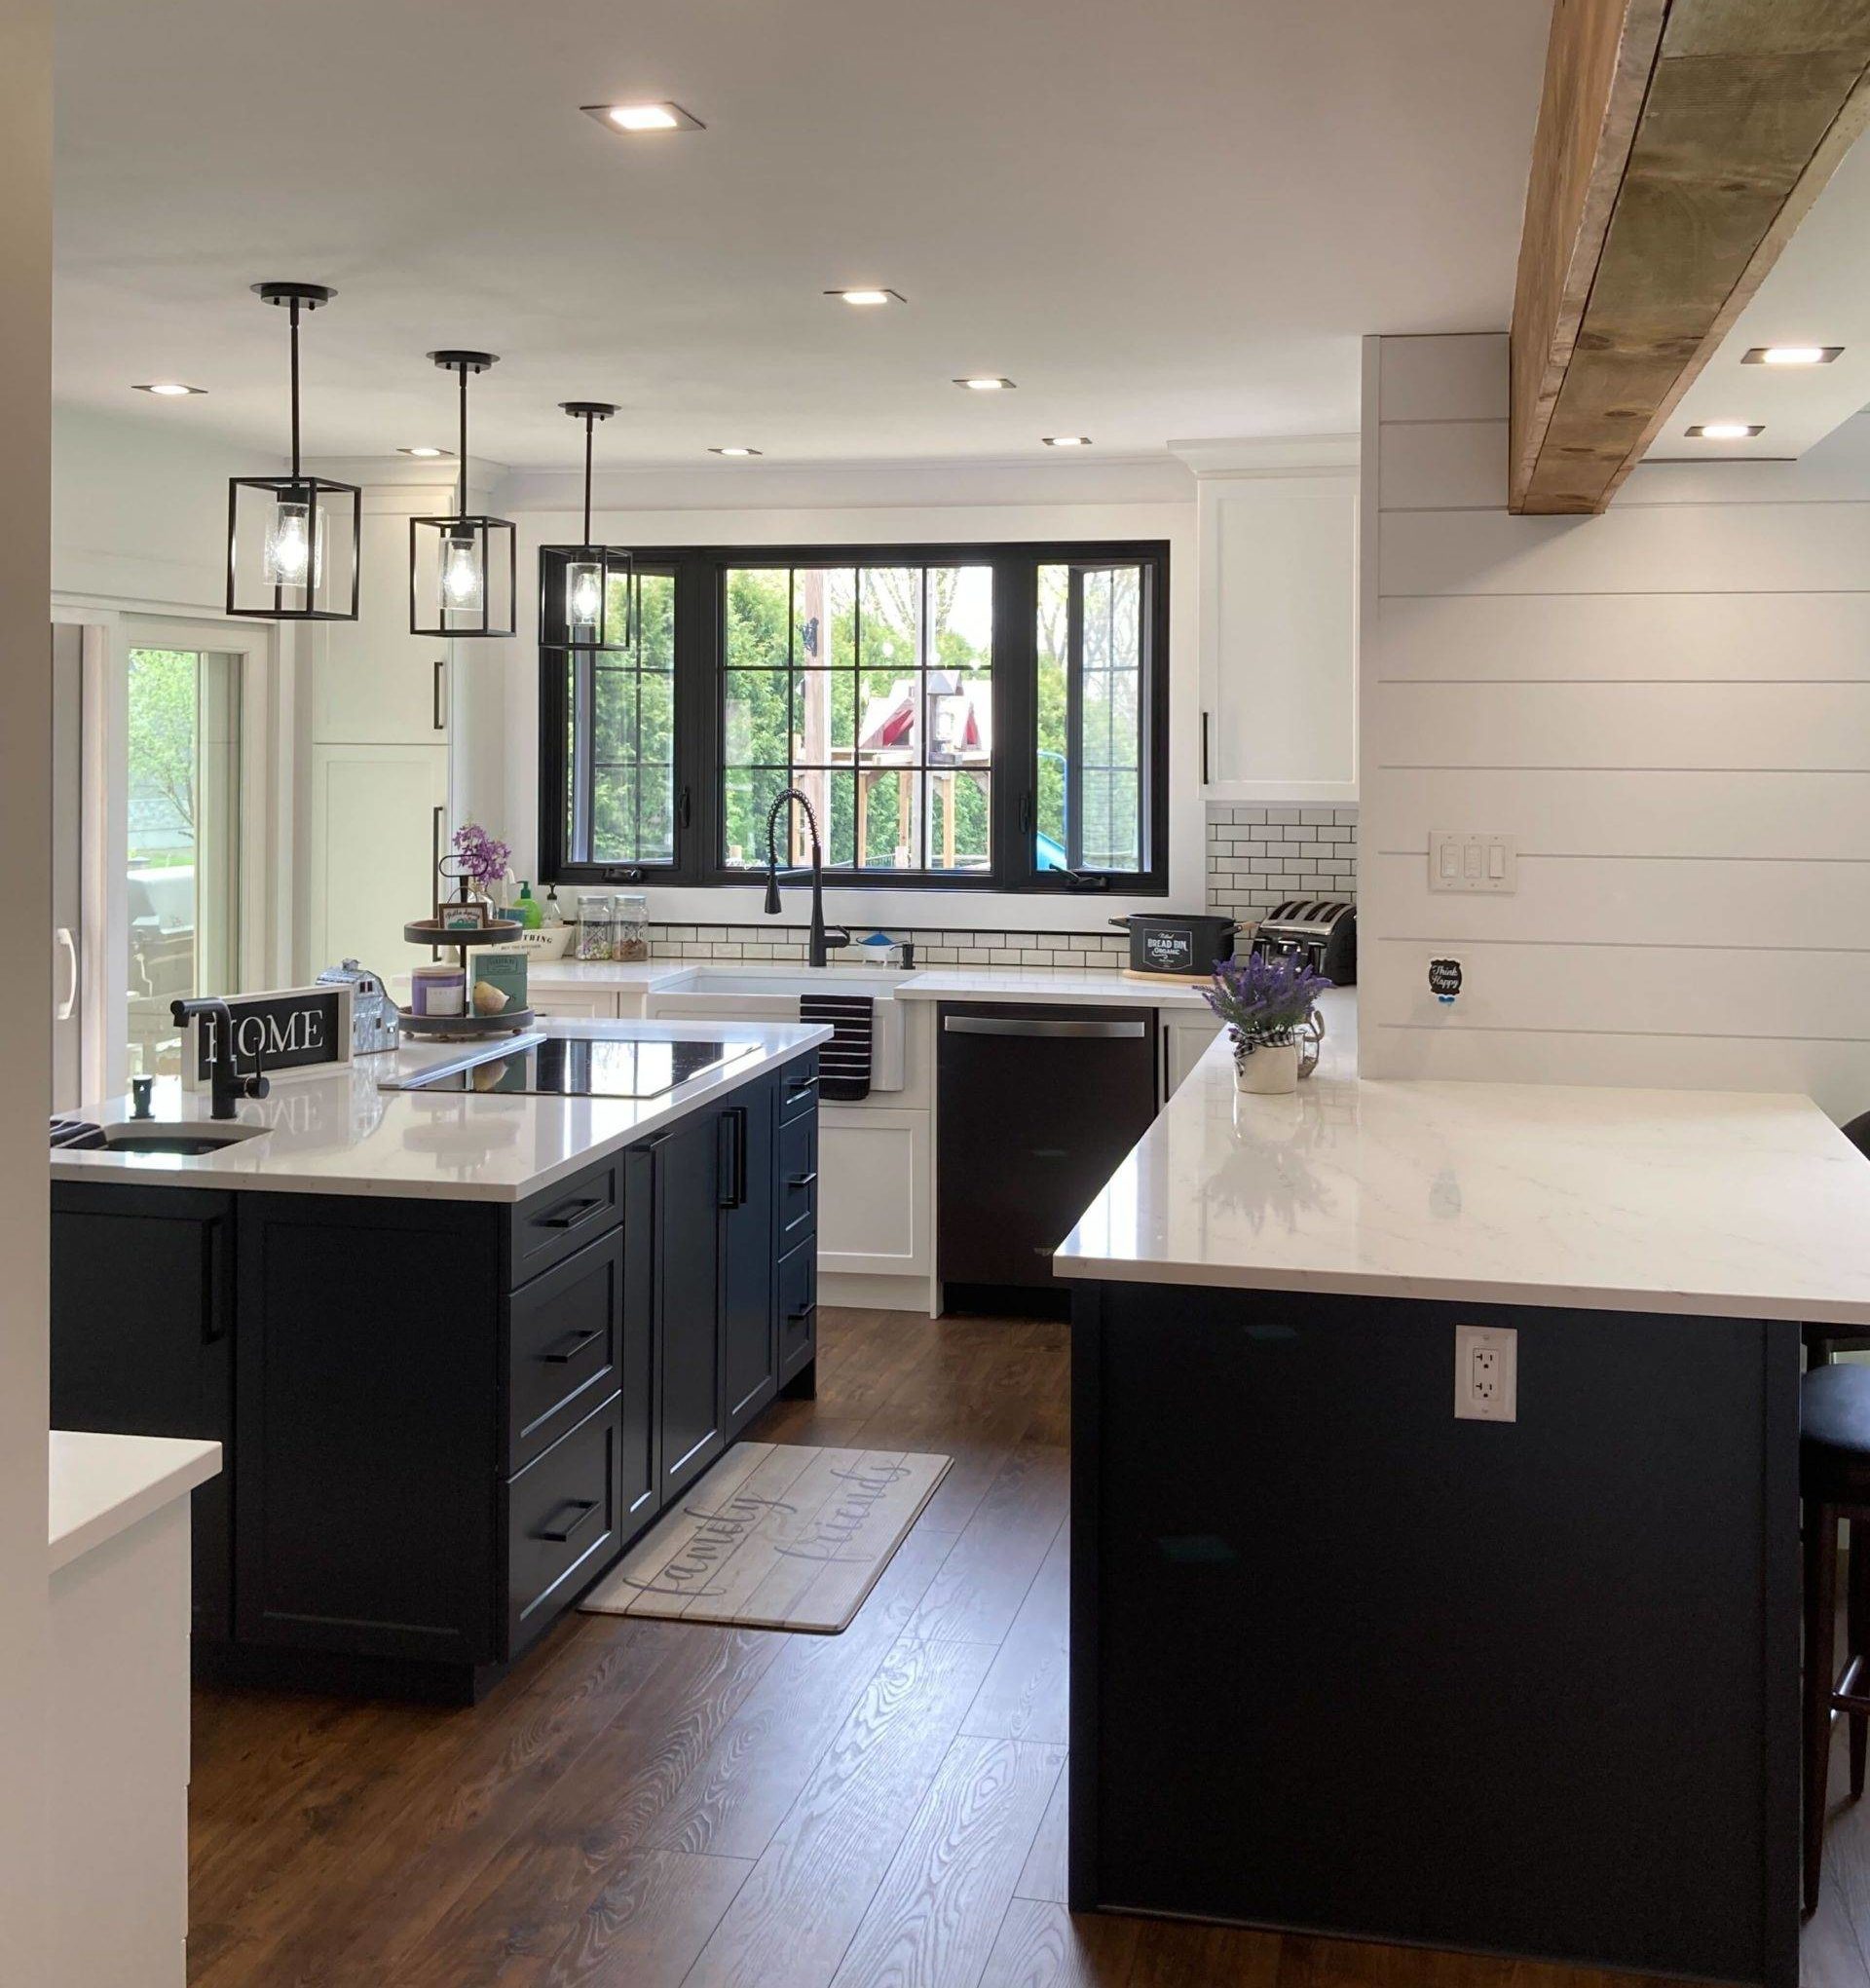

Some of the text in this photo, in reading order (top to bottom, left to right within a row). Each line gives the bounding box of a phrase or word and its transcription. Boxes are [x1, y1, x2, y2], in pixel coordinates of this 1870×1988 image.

[1147, 938, 1188, 952] BREAD BIN
[1432, 965, 1458, 976] Think
[1432, 975, 1458, 989] Happy
[623, 1483, 798, 1597] family
